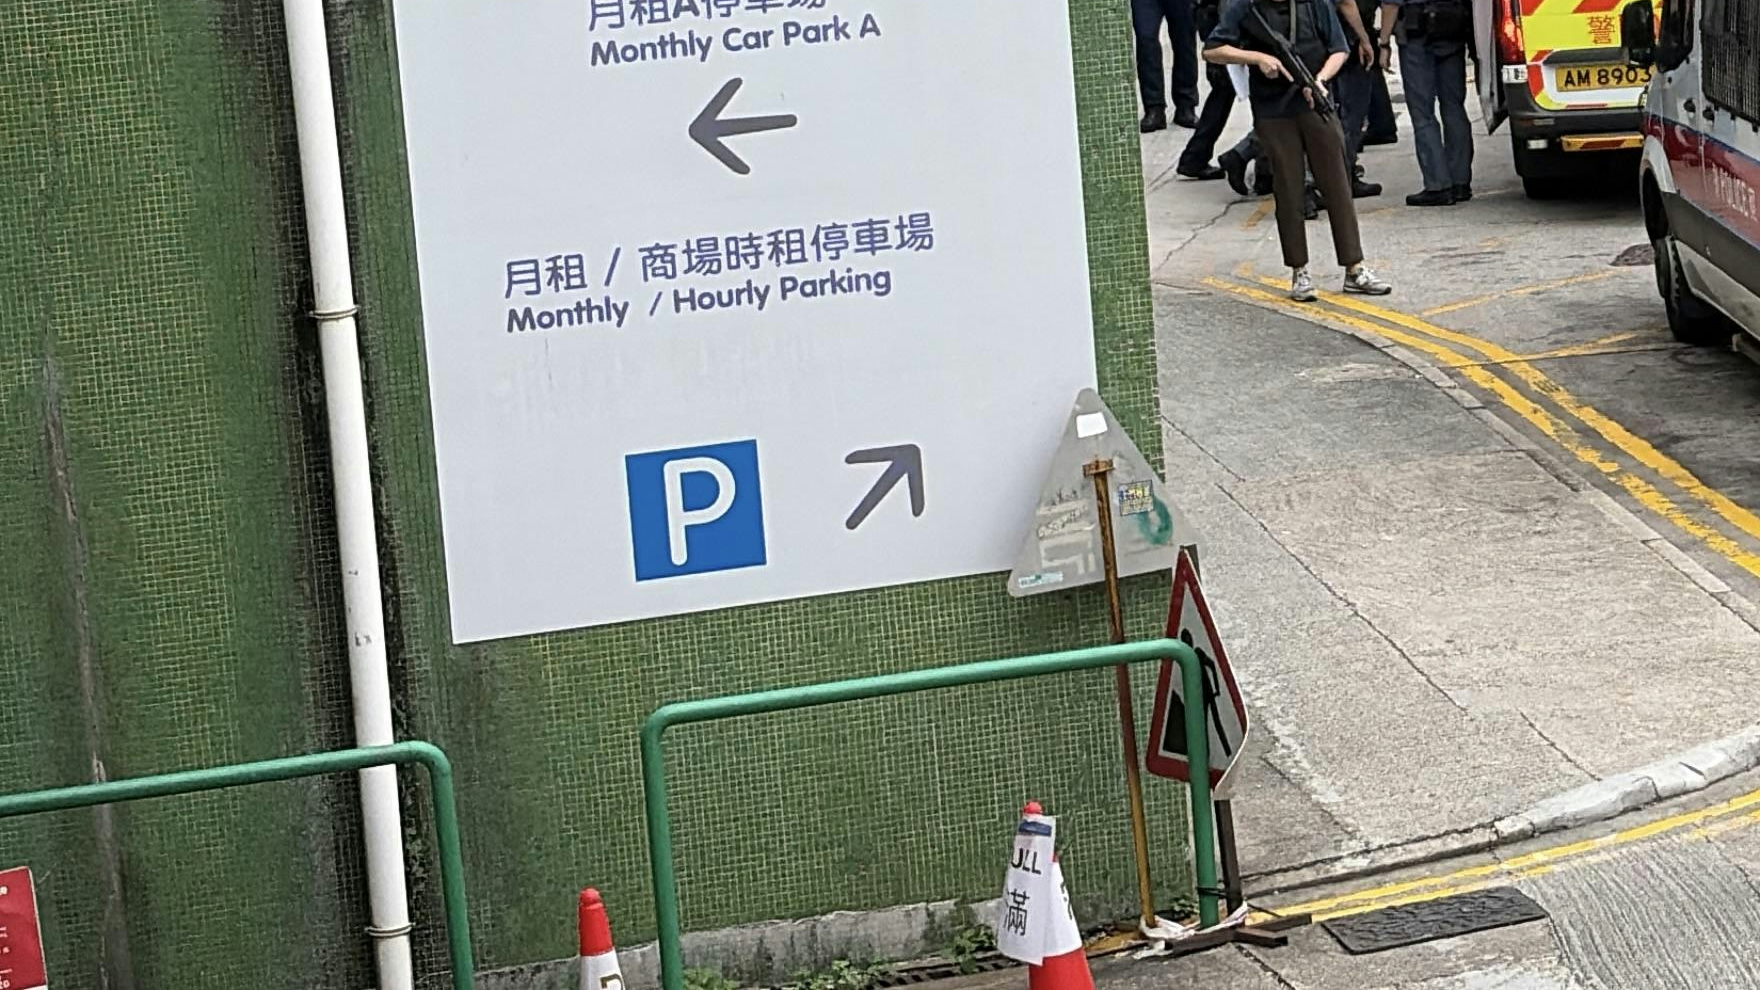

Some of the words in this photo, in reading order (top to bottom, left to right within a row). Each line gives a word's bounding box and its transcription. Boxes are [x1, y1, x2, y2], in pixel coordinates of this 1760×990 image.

[590, 29, 713, 66] Monthly
[722, 27, 774, 52] Car
[783, 14, 851, 46] Park
[859, 13, 882, 38] A
[1587, 14, 1616, 45] 警
[1564, 70, 1591, 87] AM
[1597, 66, 1652, 84] 8903
[504, 254, 588, 298] 月租
[604, 247, 622, 287] /
[638, 212, 935, 282] 商場時租停車場
[507, 297, 630, 333] Monthly
[649, 291, 662, 316] /
[673, 279, 771, 313] Hourly
[780, 265, 892, 301] Parking
[662, 456, 737, 566] P
